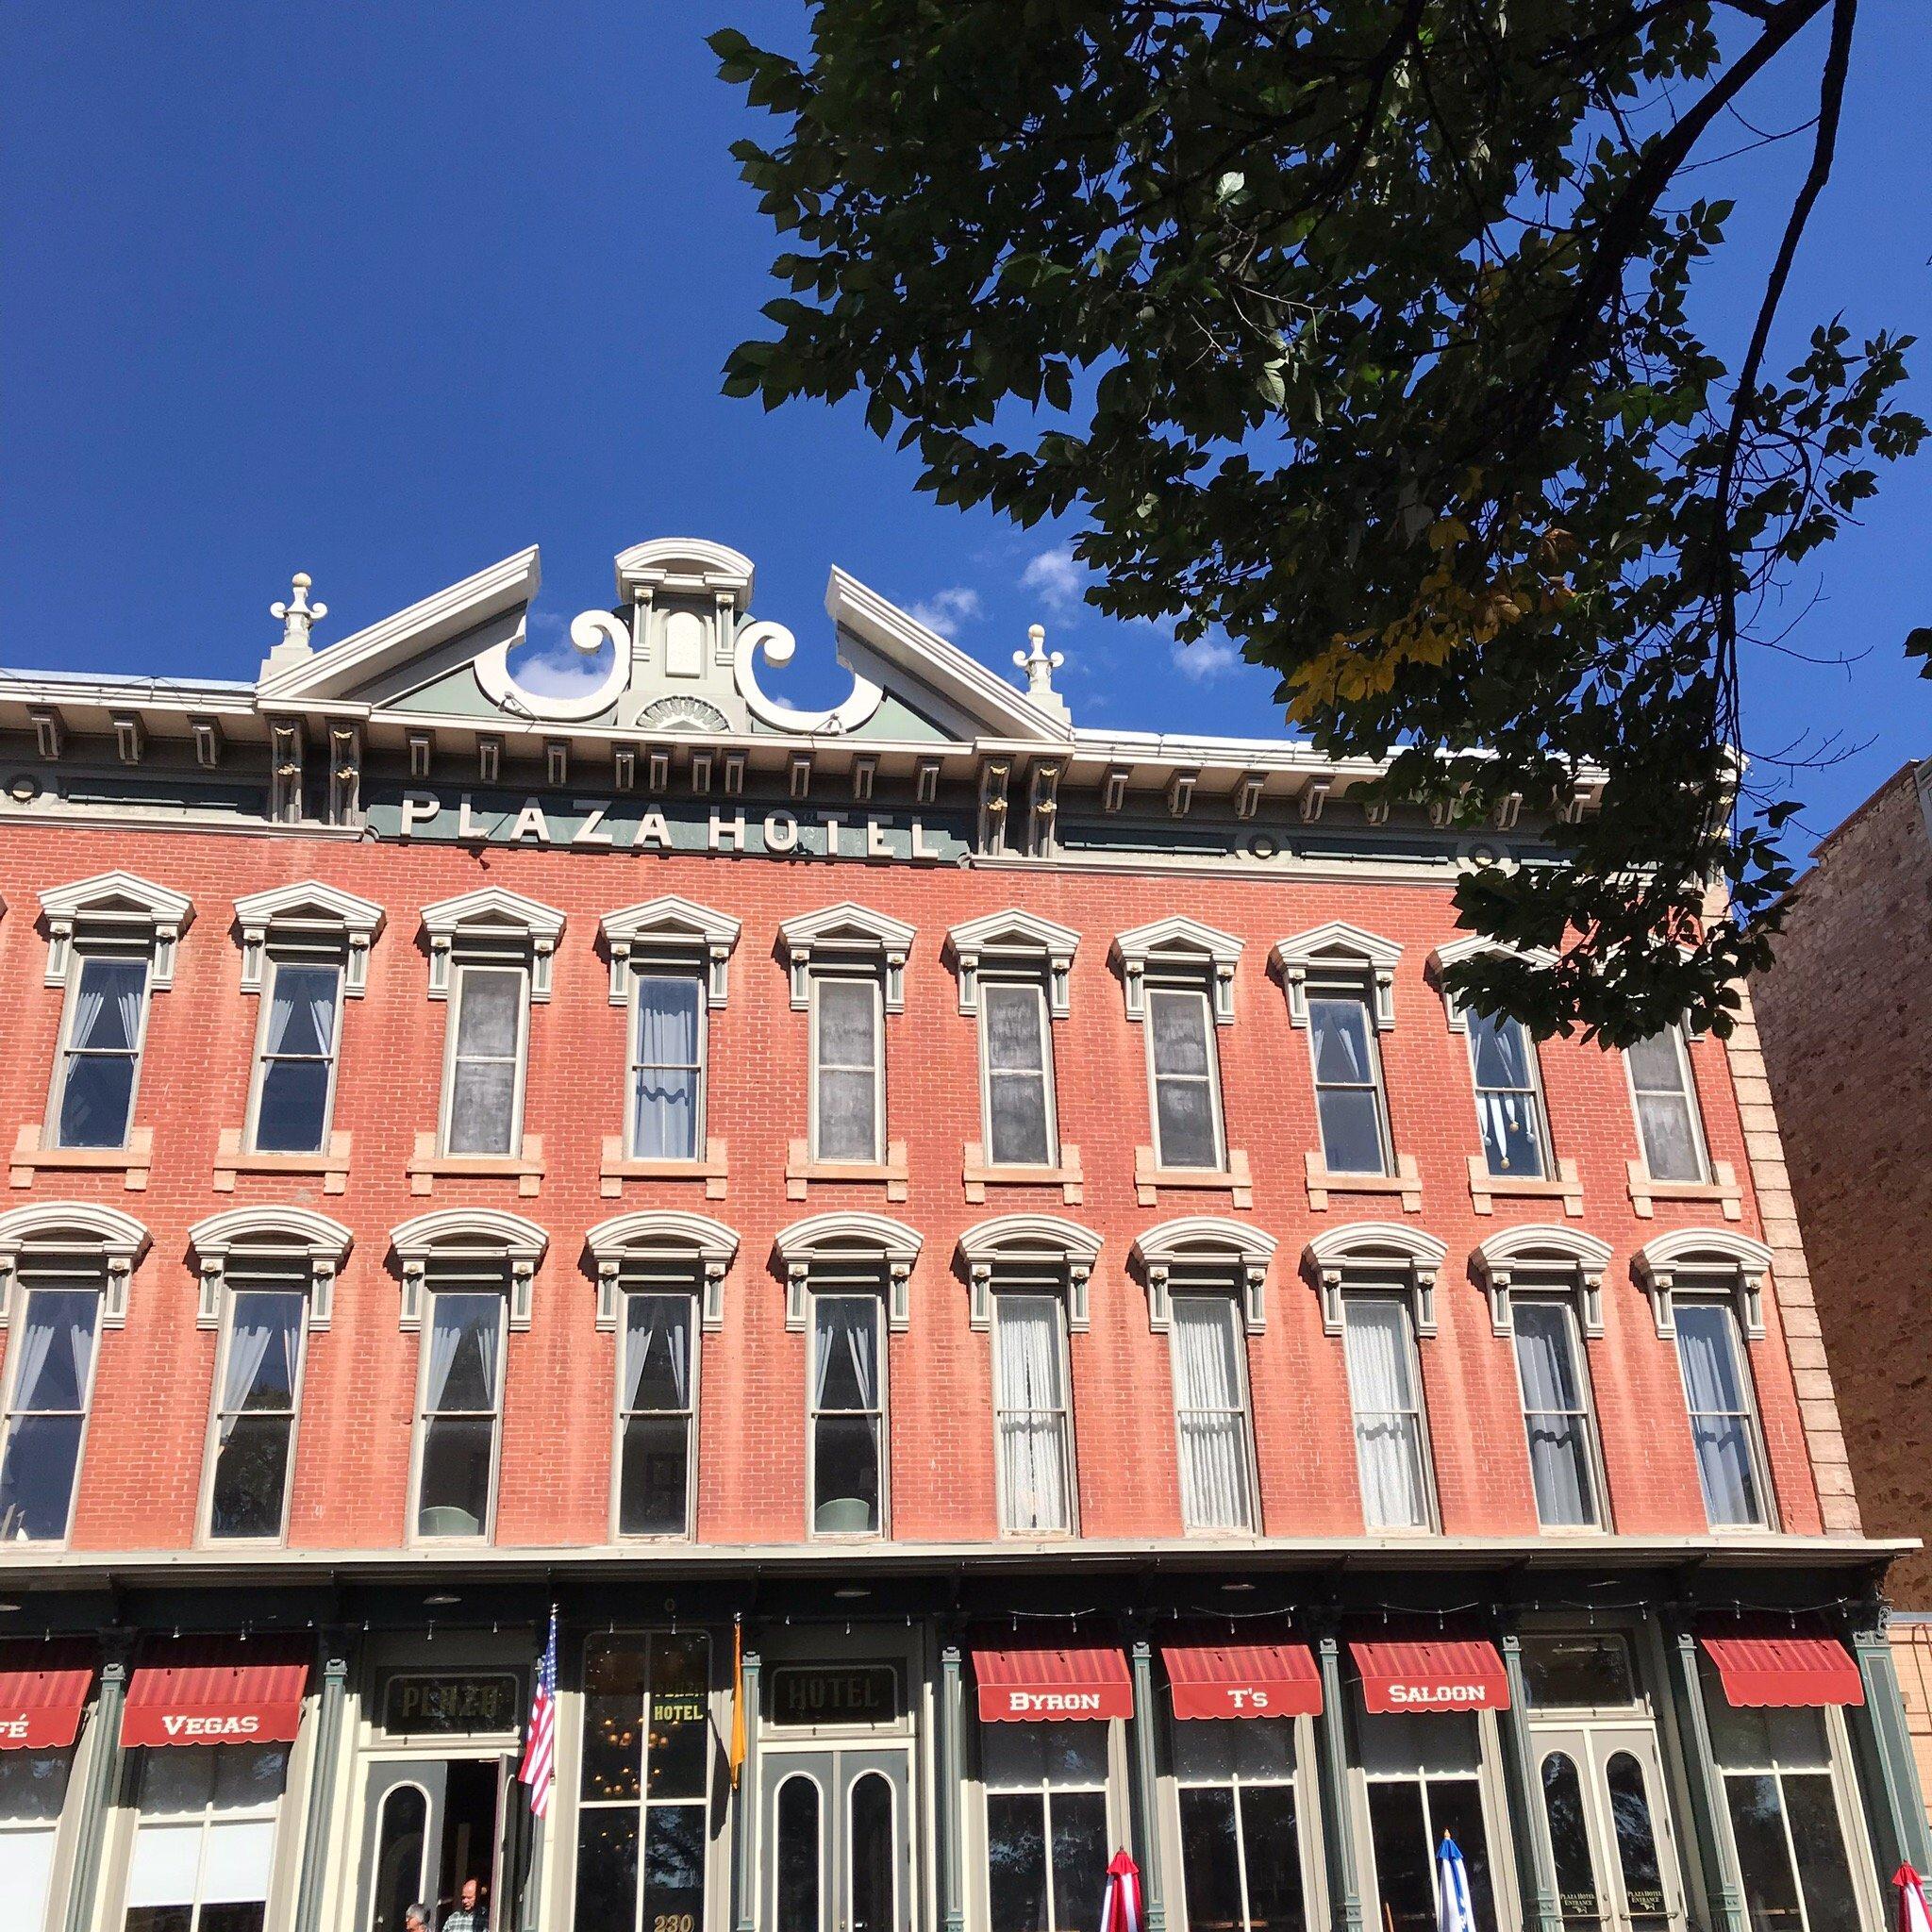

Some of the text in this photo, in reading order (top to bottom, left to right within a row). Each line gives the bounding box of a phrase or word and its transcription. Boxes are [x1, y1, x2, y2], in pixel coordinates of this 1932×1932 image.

[400, 790, 939, 861] PLAZA HOTEL
[789, 1678, 879, 1709] HOTEL
[1009, 1691, 1100, 1710] BYRON
[1388, 1685, 1486, 1703] SALOON
[654, 1705, 704, 1721] HOTEL
[161, 1715, 259, 1735] VEGAS
[654, 1914, 694, 1932] 230
